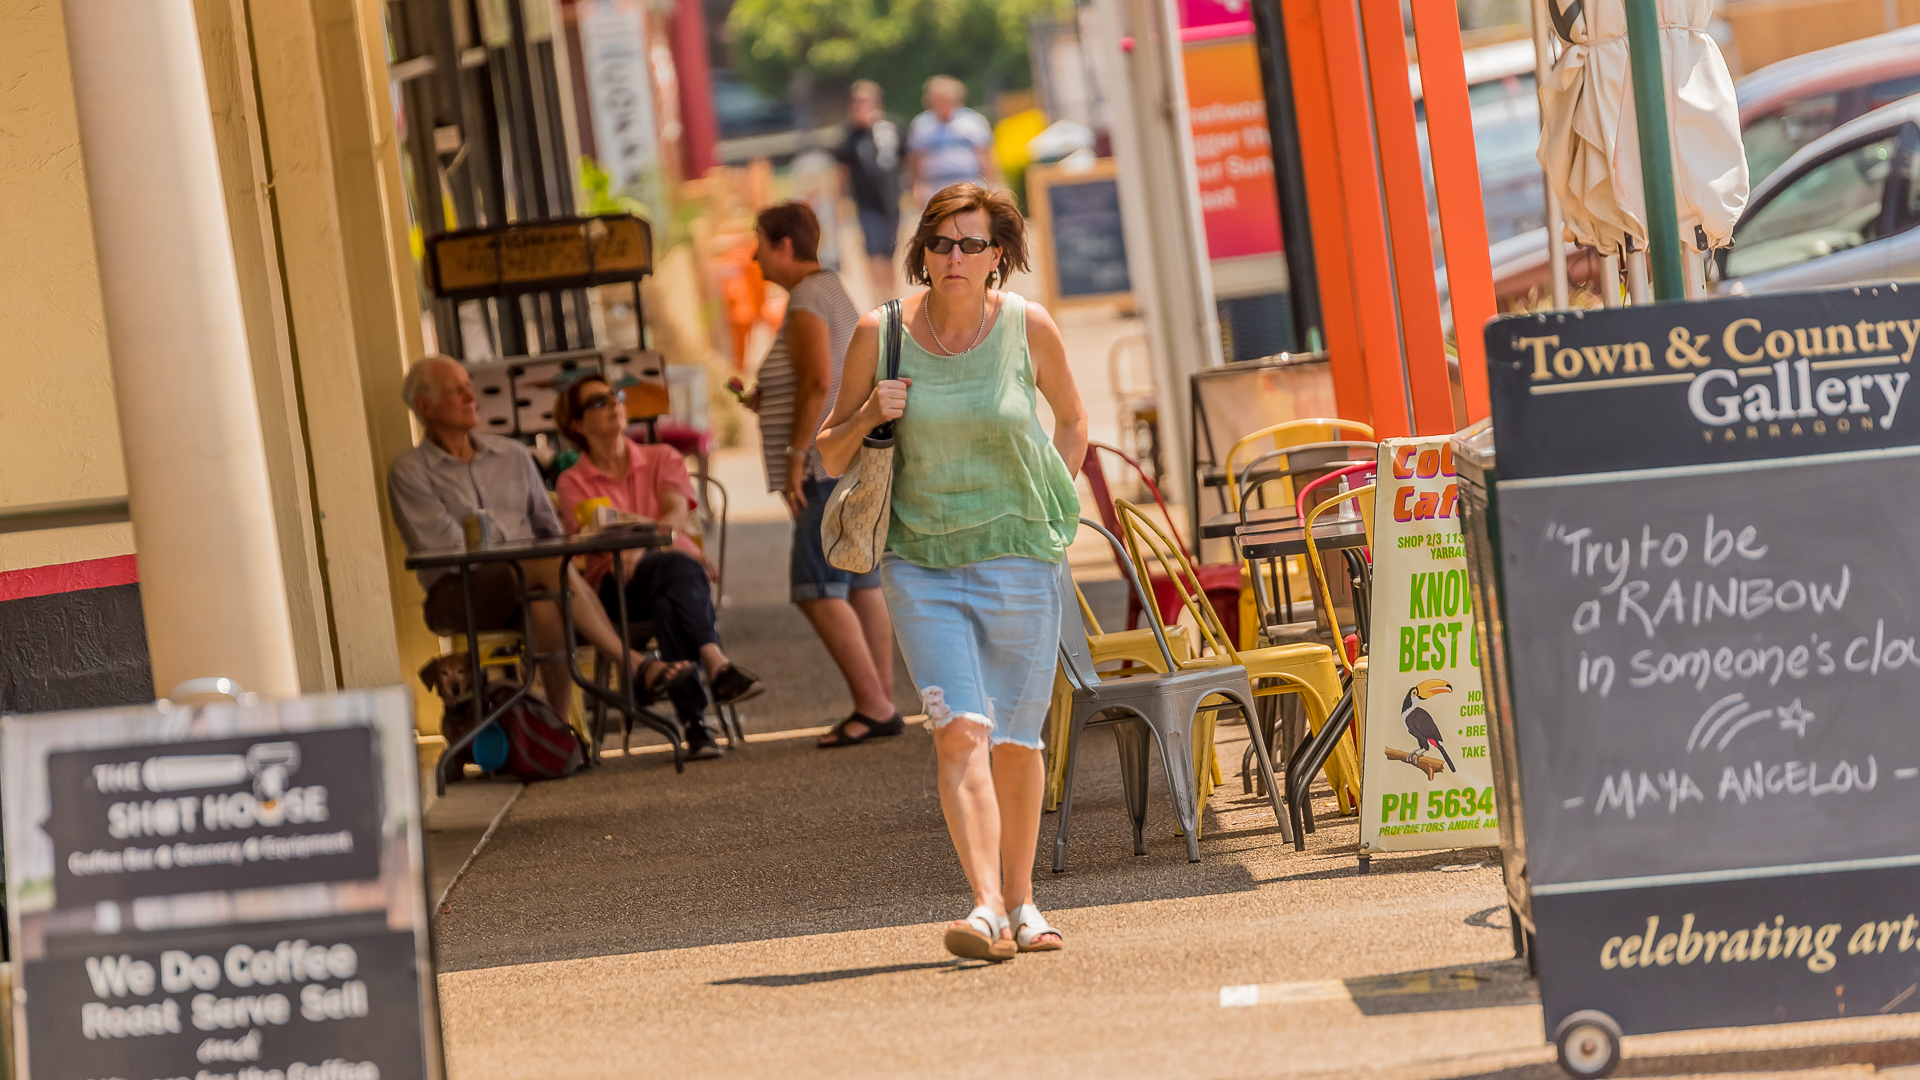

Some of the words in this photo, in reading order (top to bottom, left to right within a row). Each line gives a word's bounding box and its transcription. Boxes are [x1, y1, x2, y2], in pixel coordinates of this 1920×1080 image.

[1518, 334, 1654, 382] Town
[1665, 325, 1711, 368] &
[1722, 317, 1920, 363] Country
[1687, 357, 1911, 430] Gallery
[1702, 416, 1875, 444] YARRAGON
[1393, 484, 1460, 522] Caf
[1397, 534, 1424, 549] SHOP
[1426, 532, 1442, 546] 2/3
[1445, 532, 1465, 545] 113
[1640, 522, 1689, 570] to
[1703, 512, 1769, 568] be
[1572, 598, 1601, 634] a
[1616, 563, 1851, 638] RAINBOW
[1399, 621, 1463, 673] BEST
[1578, 650, 1615, 697] in
[1628, 631, 1836, 692] someone's
[1461, 745, 1486, 758] TAKE
[1466, 724, 1488, 737] BRE
[91, 761, 142, 794] THE
[1381, 791, 1419, 823] PH
[1427, 786, 1494, 820] 5634
[1594, 767, 1704, 820] MAYA
[1717, 753, 1879, 805] ANGELOU
[1379, 821, 1447, 837] PROPRIETORS
[1483, 817, 1499, 829] AN
[85, 953, 156, 999] We
[160, 949, 221, 993] Do
[224, 939, 358, 987] Coffee
[1599, 911, 1843, 973] celebrating
[82, 997, 182, 1040] Roast
[190, 993, 291, 1031] Serve
[300, 980, 368, 1022] Sell
